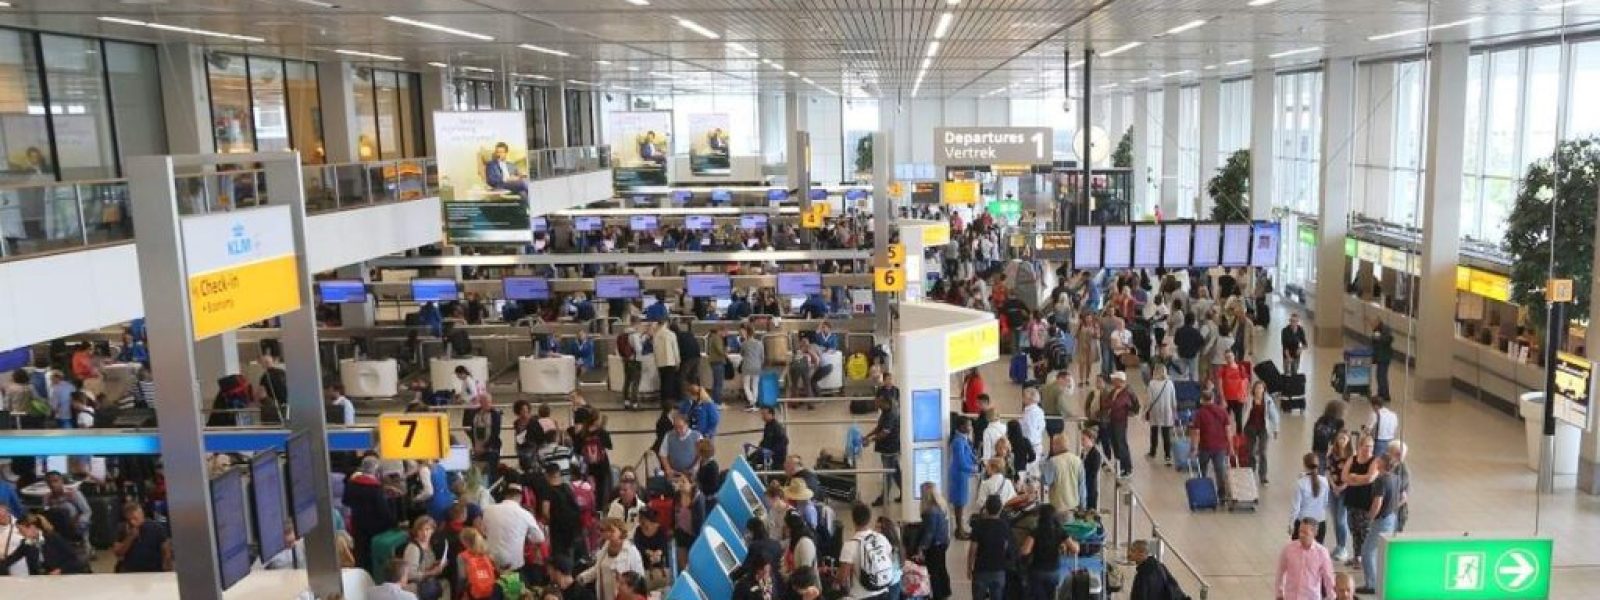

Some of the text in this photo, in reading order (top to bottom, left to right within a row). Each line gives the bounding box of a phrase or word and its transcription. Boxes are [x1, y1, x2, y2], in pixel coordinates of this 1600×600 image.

[944, 146, 997, 159] Vertrek
[945, 131, 1044, 158] Departures 1
[228, 239, 251, 255] KLM
[888, 246, 896, 258] 5
[200, 273, 239, 296] Check-in
[885, 270, 895, 286] 6
[398, 421, 417, 447] 7
